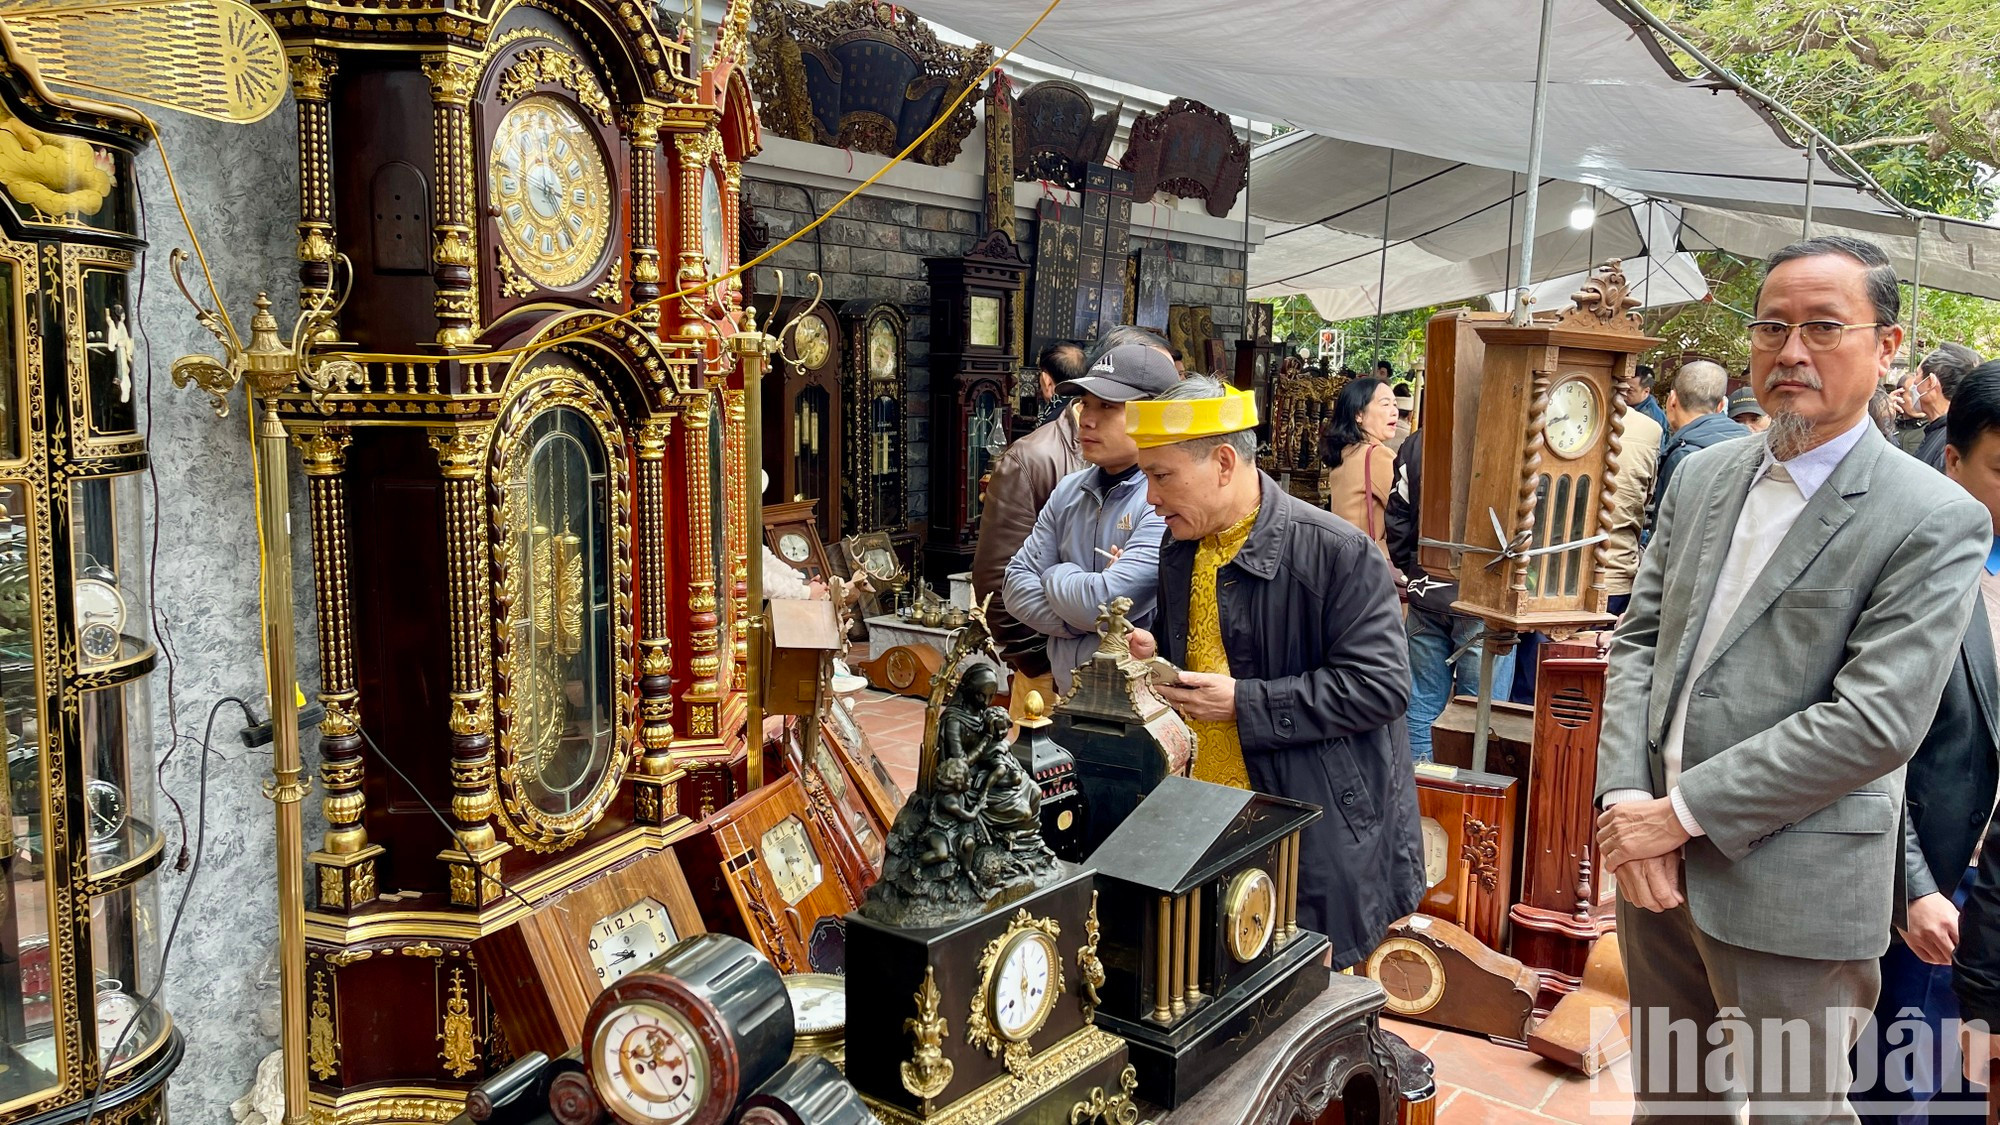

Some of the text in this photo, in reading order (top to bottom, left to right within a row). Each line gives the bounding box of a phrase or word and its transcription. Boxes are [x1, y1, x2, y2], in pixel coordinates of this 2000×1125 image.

[1566, 385, 1573, 393] 12
[1582, 401, 1587, 409] 2
[1583, 415, 1588, 423] 3
[1558, 440, 1564, 448] 6
[1569, 438, 1575, 446] 5
[109, 794, 116, 802] 2
[104, 824, 111, 832] 5
[790, 825, 797, 836] 2
[800, 843, 807, 854] 3
[801, 876, 809, 887] 5
[788, 886, 795, 898] 7
[629, 912, 635, 923] 1
[646, 908, 654, 920] 2
[614, 918, 625, 930] 12
[603, 924, 613, 936] 11
[658, 932, 667, 944] 3
[588, 938, 599, 952] 10
[596, 967, 605, 979] 9
